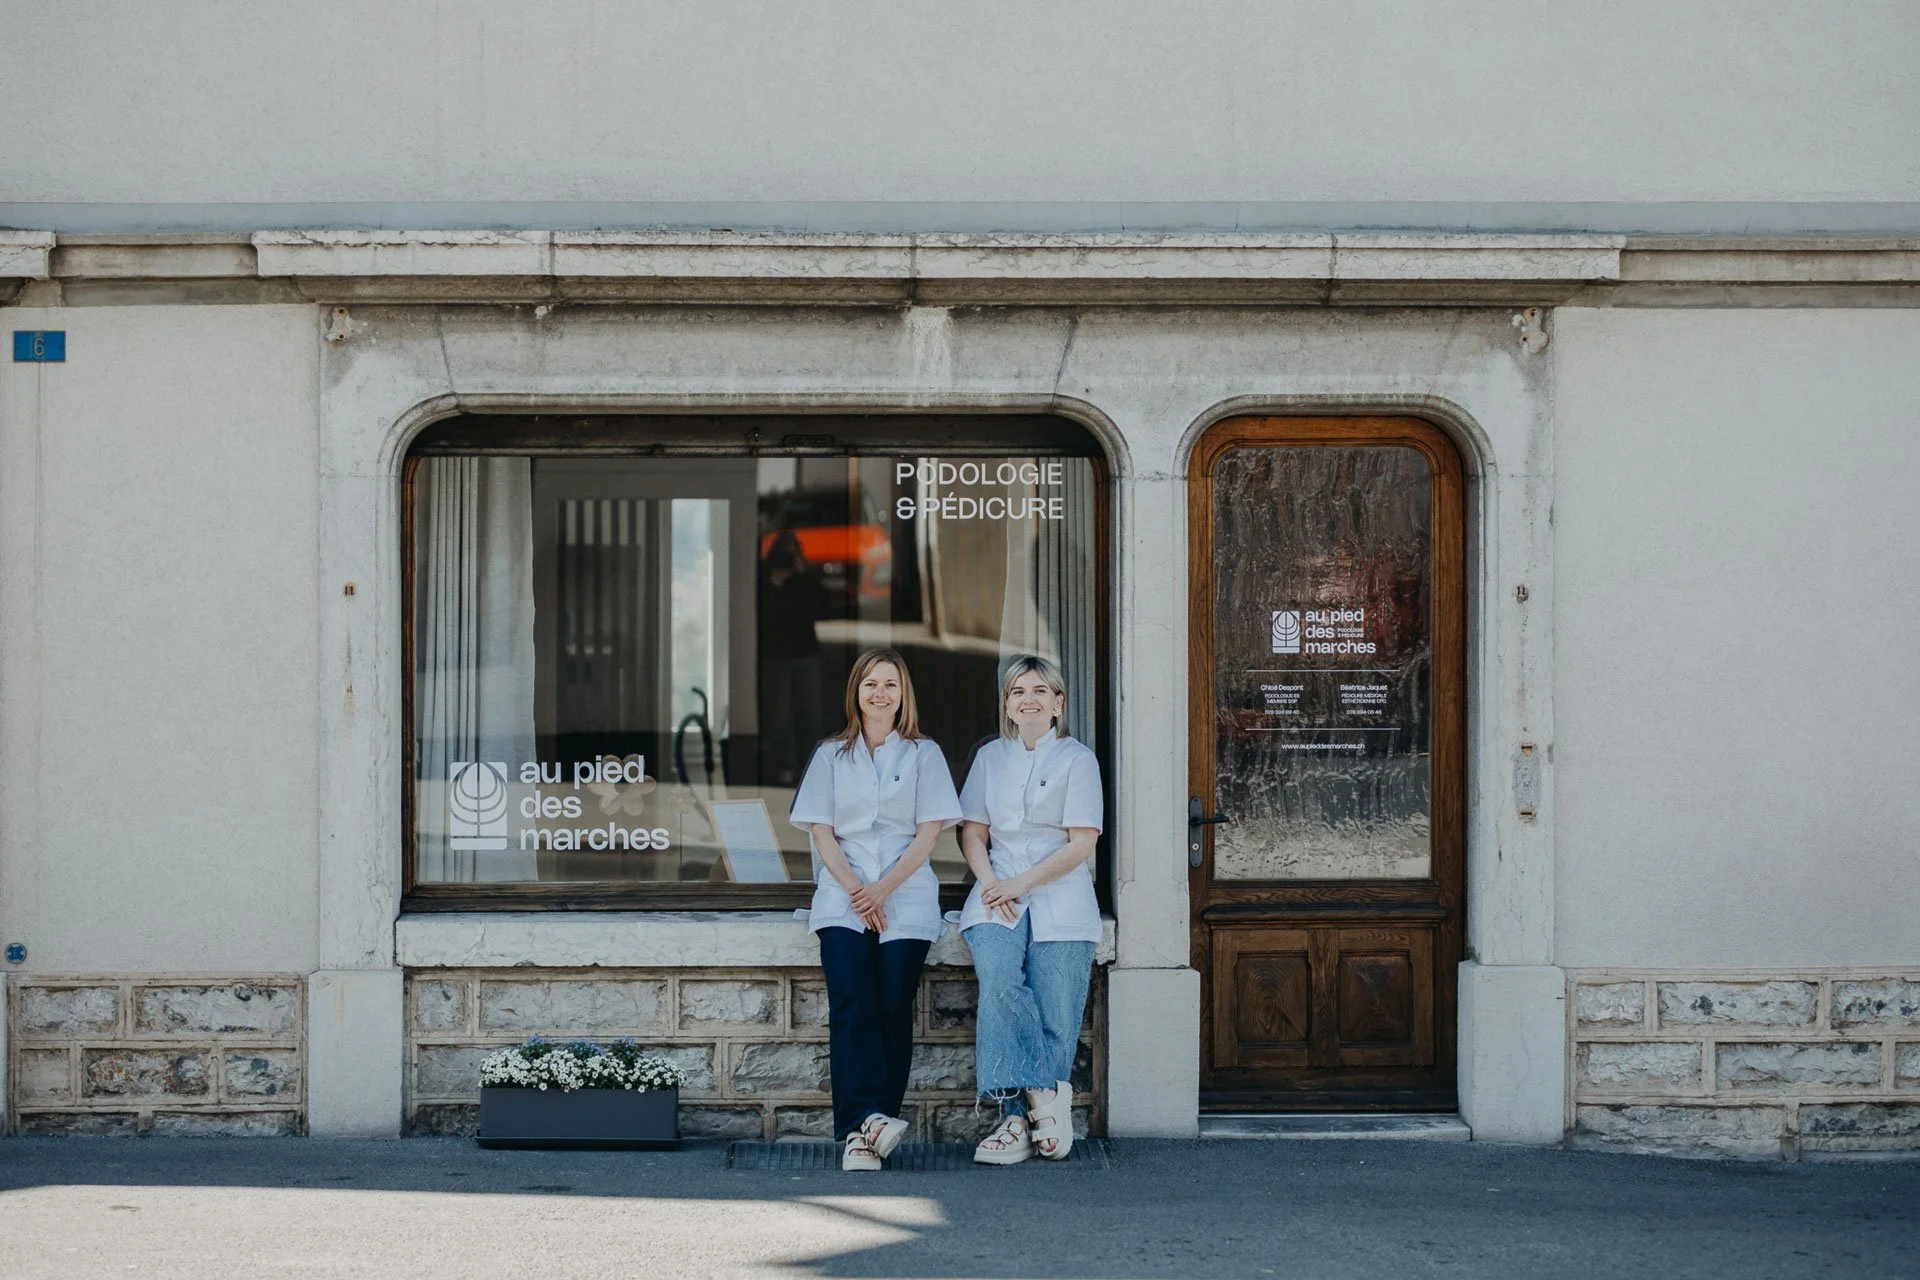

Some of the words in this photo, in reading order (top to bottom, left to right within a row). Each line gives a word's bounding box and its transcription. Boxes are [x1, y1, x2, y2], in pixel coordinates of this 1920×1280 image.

[33, 337, 46, 356] 6
[896, 462, 1063, 486] PODOLOGIE
[896, 496, 916, 520] &
[923, 491, 1064, 520] PÉDICURE
[1305, 610, 1325, 622] au
[1330, 607, 1365, 625] pied
[1305, 624, 1335, 639] des
[1305, 639, 1377, 654] marches
[519, 760, 562, 784] au
[573, 754, 645, 790] pied
[519, 790, 582, 818] des
[519, 821, 670, 851] marches
